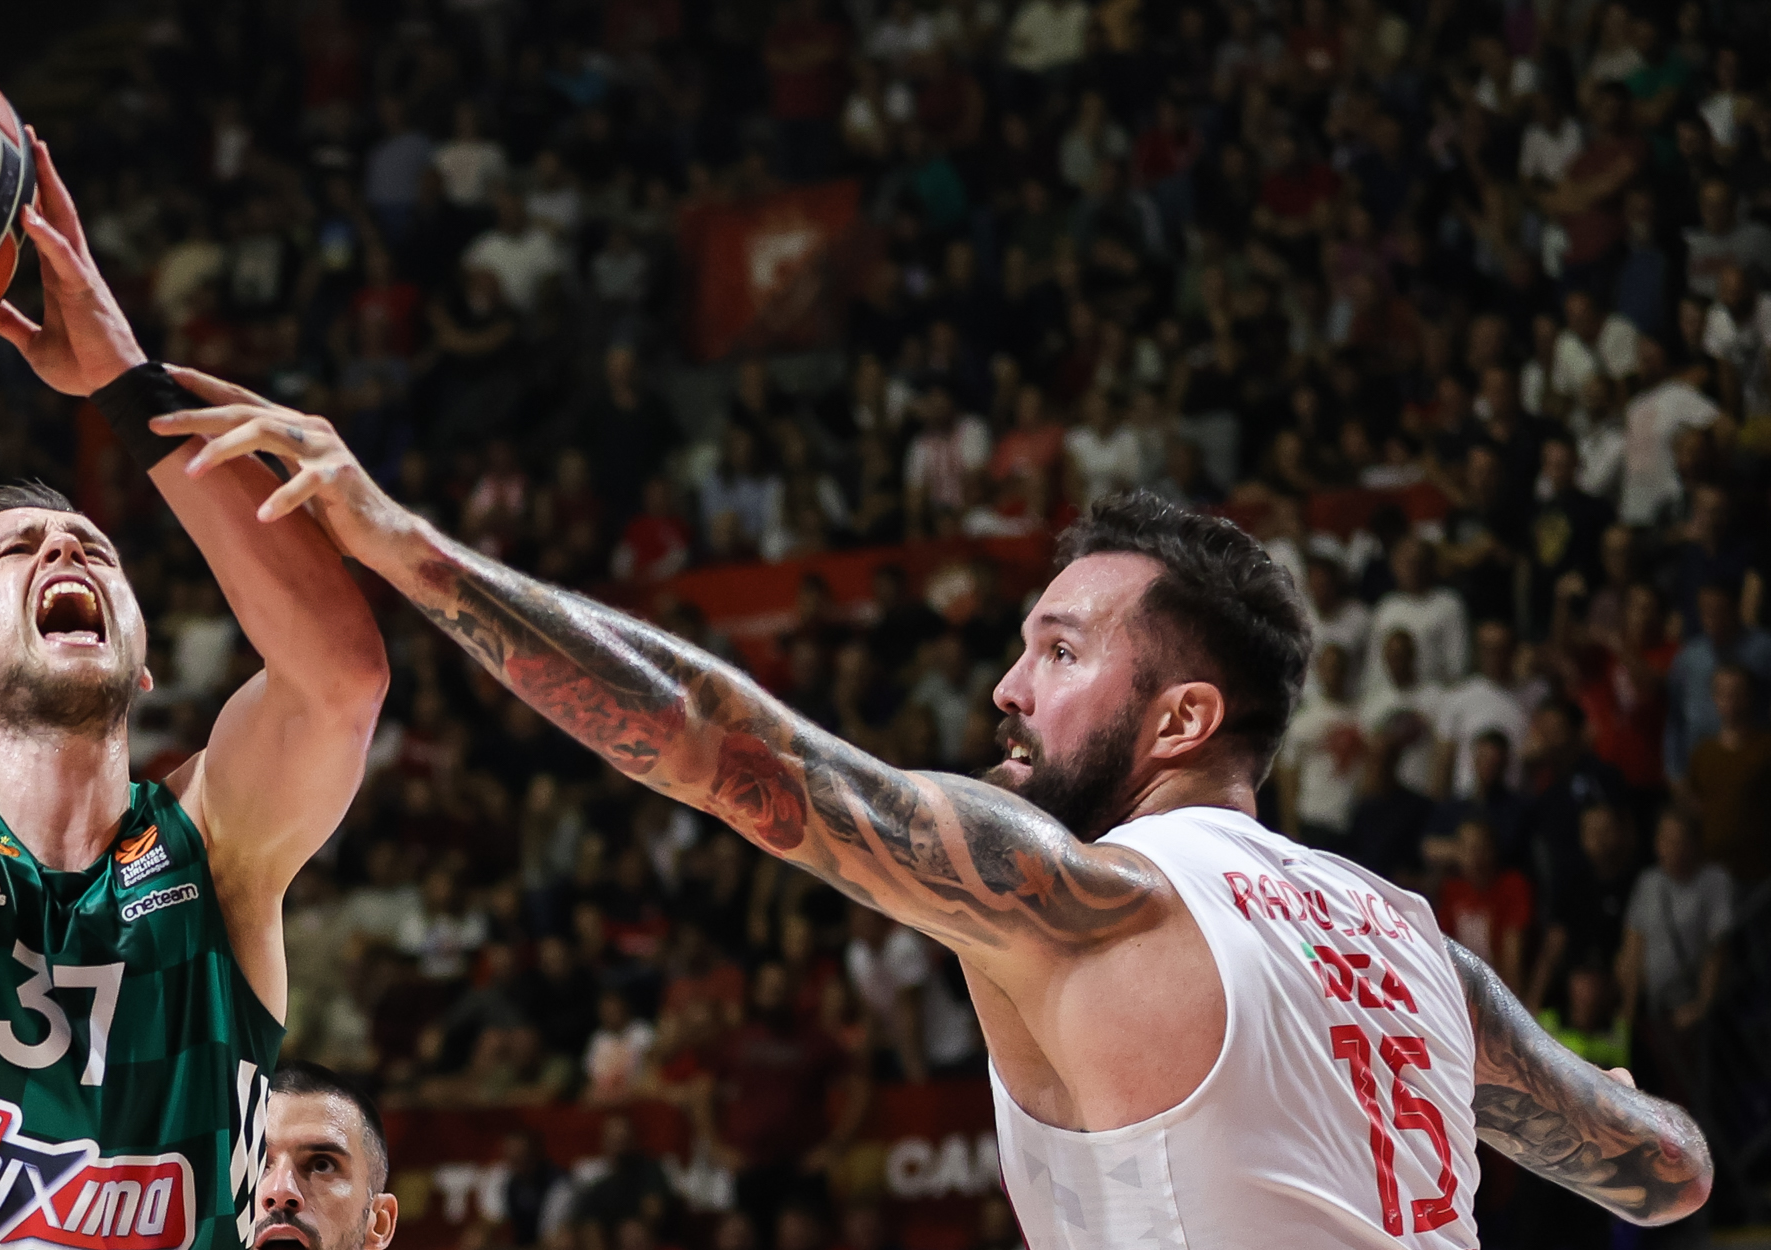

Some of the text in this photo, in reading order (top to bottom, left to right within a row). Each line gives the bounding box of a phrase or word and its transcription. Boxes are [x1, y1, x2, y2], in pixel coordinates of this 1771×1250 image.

[120, 844, 165, 875] TURKISH
[124, 852, 168, 881] AIRLINES
[122, 884, 198, 920] oneteam
[1329, 1024, 1459, 1237] 15
